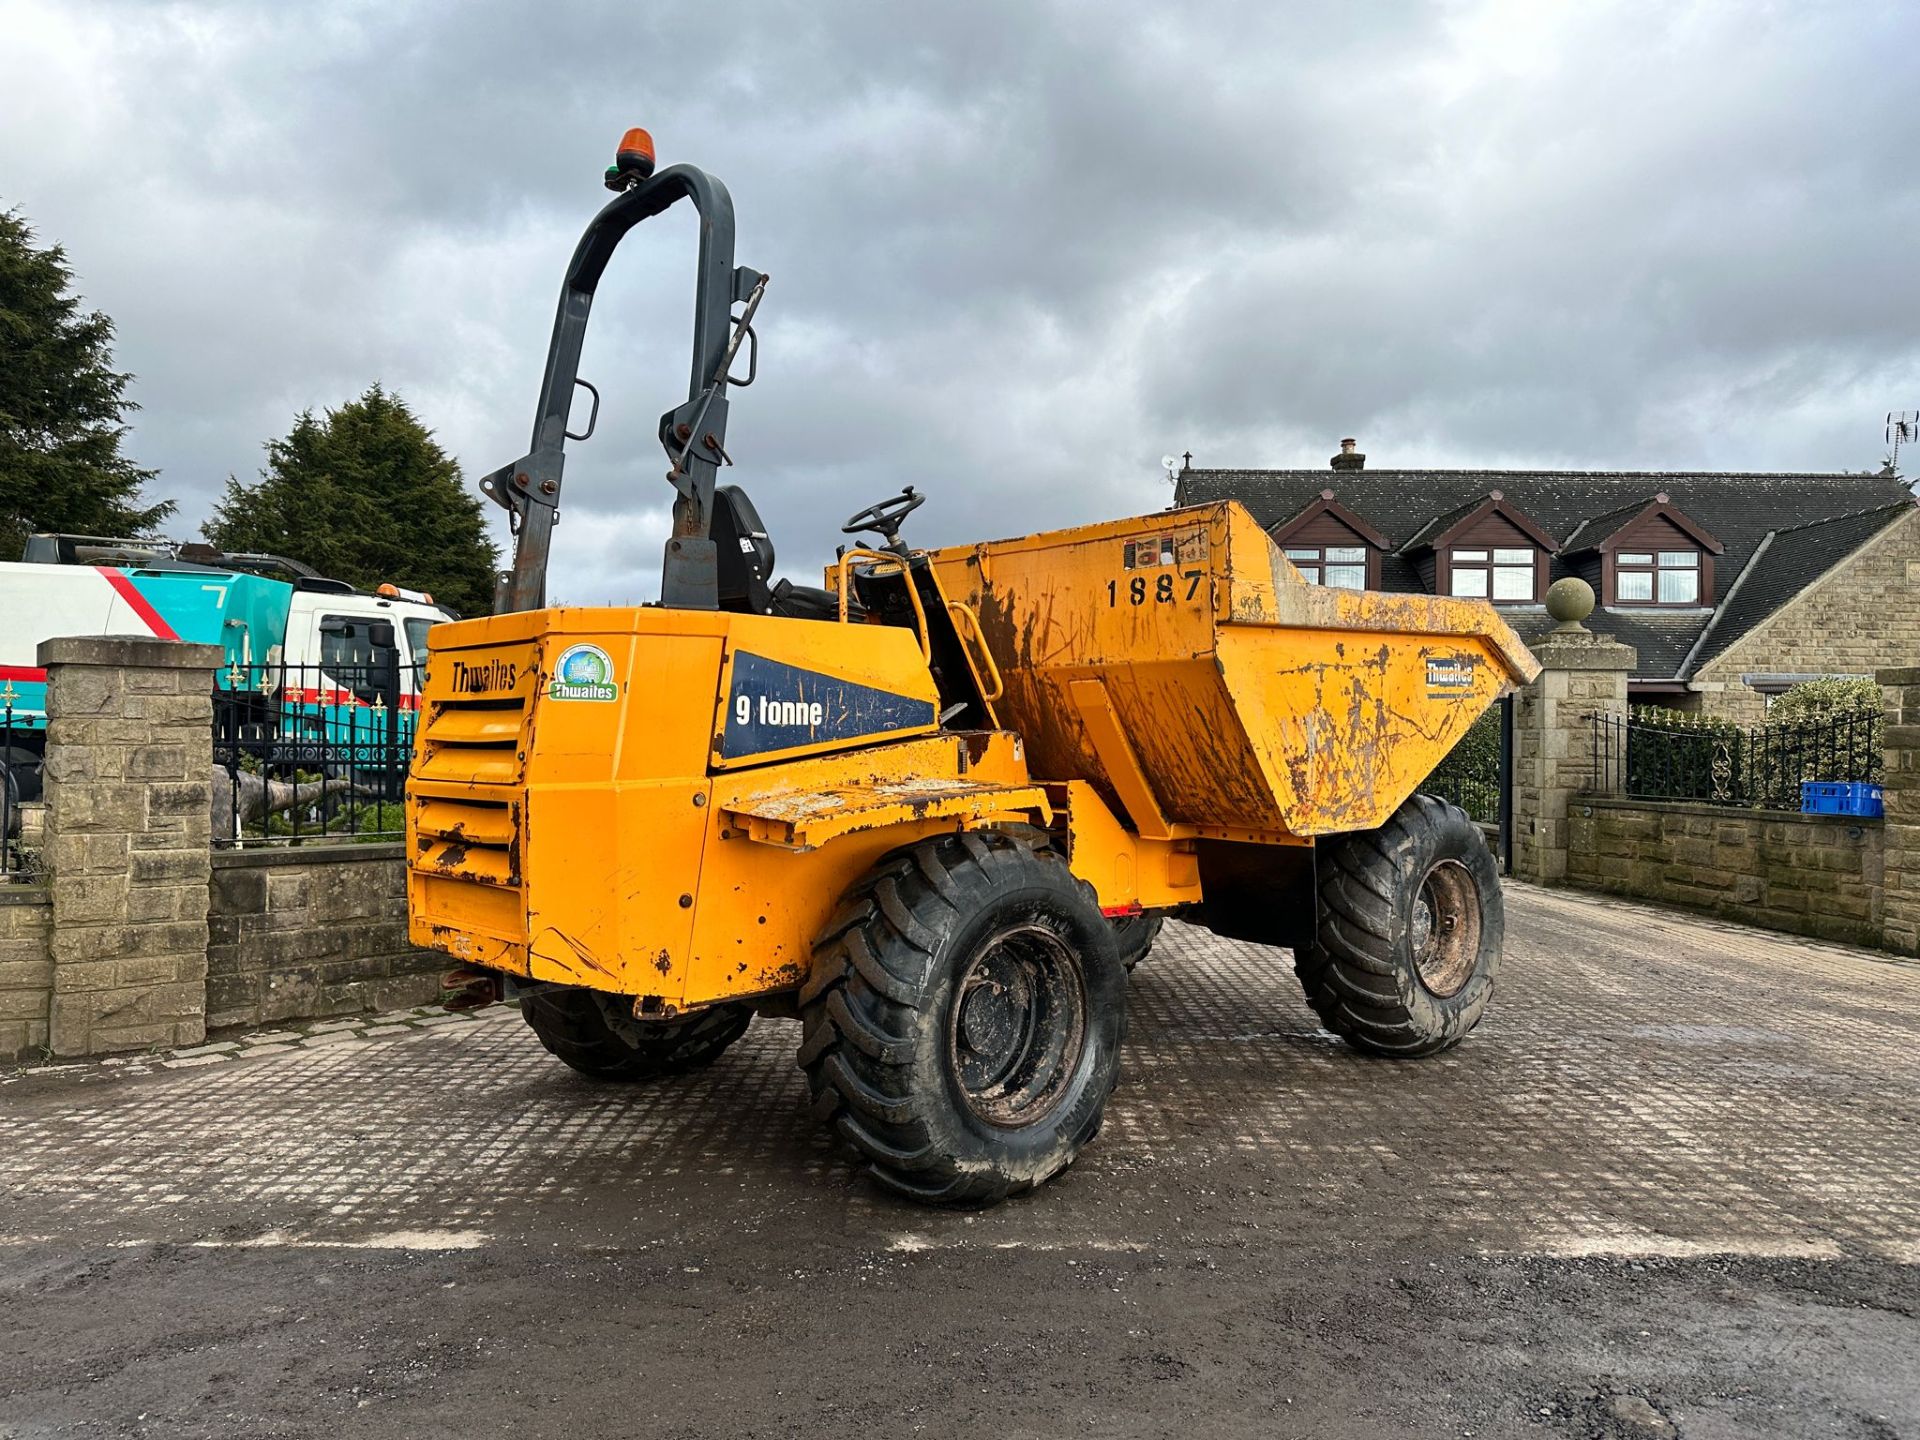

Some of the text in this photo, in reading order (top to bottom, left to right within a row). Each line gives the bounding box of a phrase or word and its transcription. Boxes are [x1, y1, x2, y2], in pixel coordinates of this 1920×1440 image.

[201, 585, 228, 609] 7
[1108, 570, 1201, 608] 1887
[452, 658, 517, 692] Thwaites
[555, 684, 613, 699] Thwaites
[736, 695, 823, 726] 9 tonne
